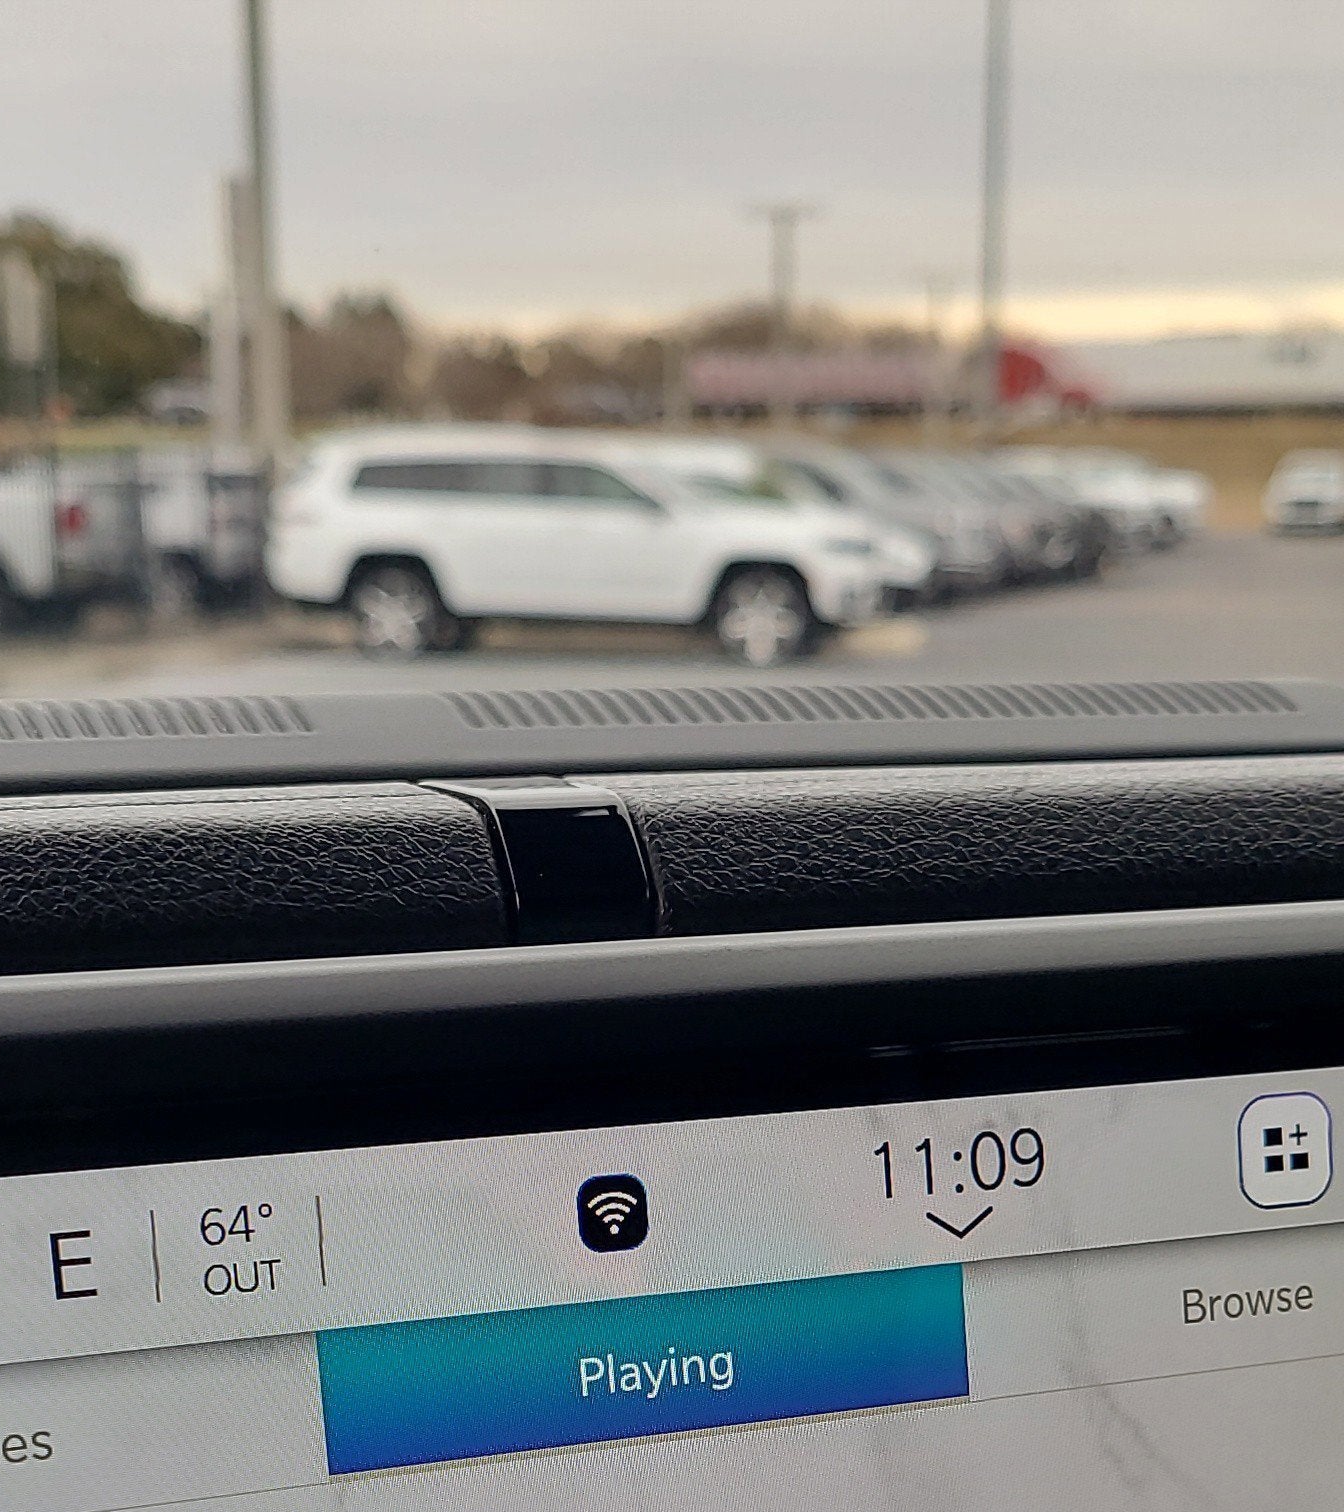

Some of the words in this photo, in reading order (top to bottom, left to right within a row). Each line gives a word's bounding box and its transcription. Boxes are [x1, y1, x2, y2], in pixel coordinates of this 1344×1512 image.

[873, 1126, 1045, 1199] 11:09
[200, 1203, 274, 1247] 64°
[49, 1229, 99, 1301] E
[203, 1258, 283, 1297] OUT
[1181, 1280, 1314, 1325] Browse
[578, 1345, 736, 1401] Playing
